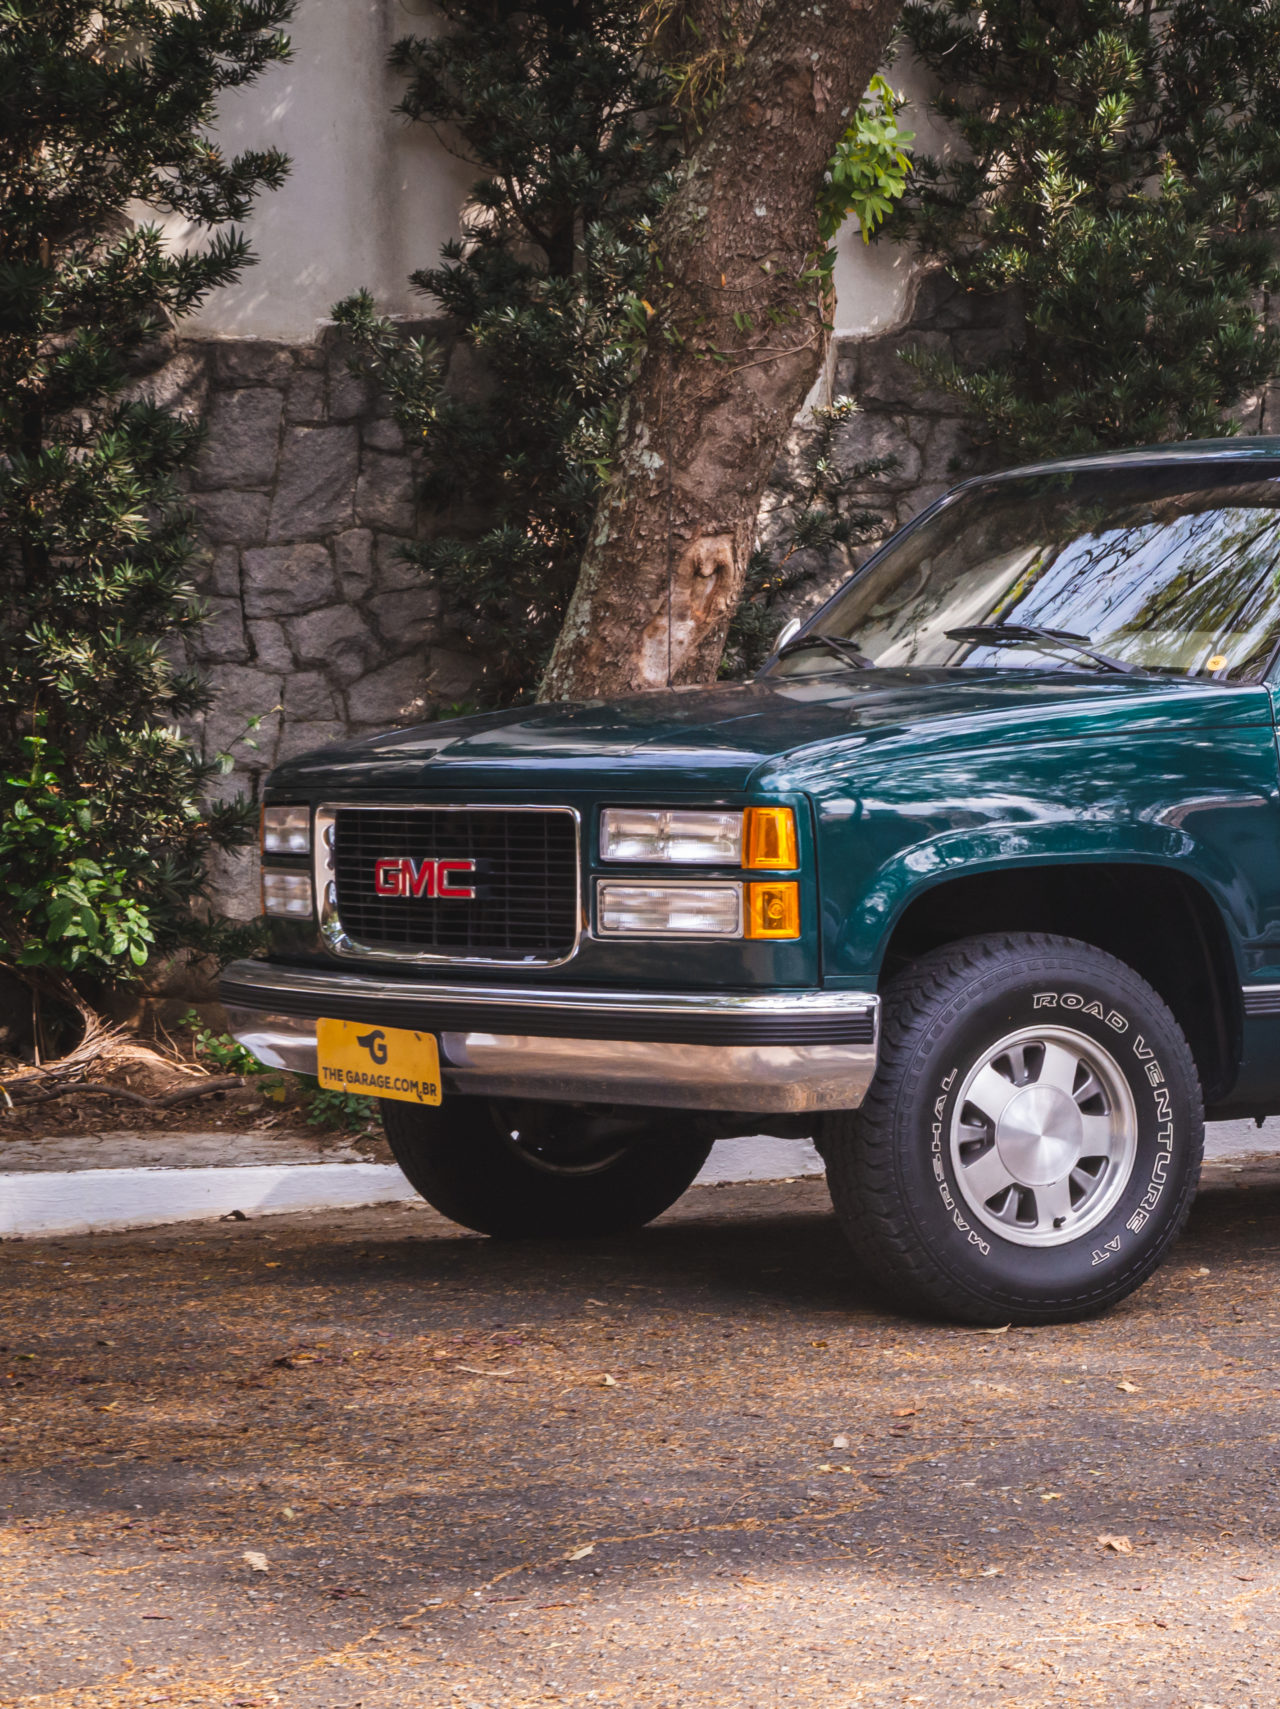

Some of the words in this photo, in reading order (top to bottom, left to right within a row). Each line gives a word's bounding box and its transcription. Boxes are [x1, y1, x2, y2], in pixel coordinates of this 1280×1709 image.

[375, 857, 476, 899] GMC
[1033, 993, 1129, 1033] ROAD
[322, 1066, 344, 1082] THE
[345, 1070, 437, 1097] GARAGE.COM.BR
[1125, 1034, 1173, 1234] VENTURE
[931, 1068, 990, 1256] MARSHAL
[1091, 1234, 1121, 1266] AT
